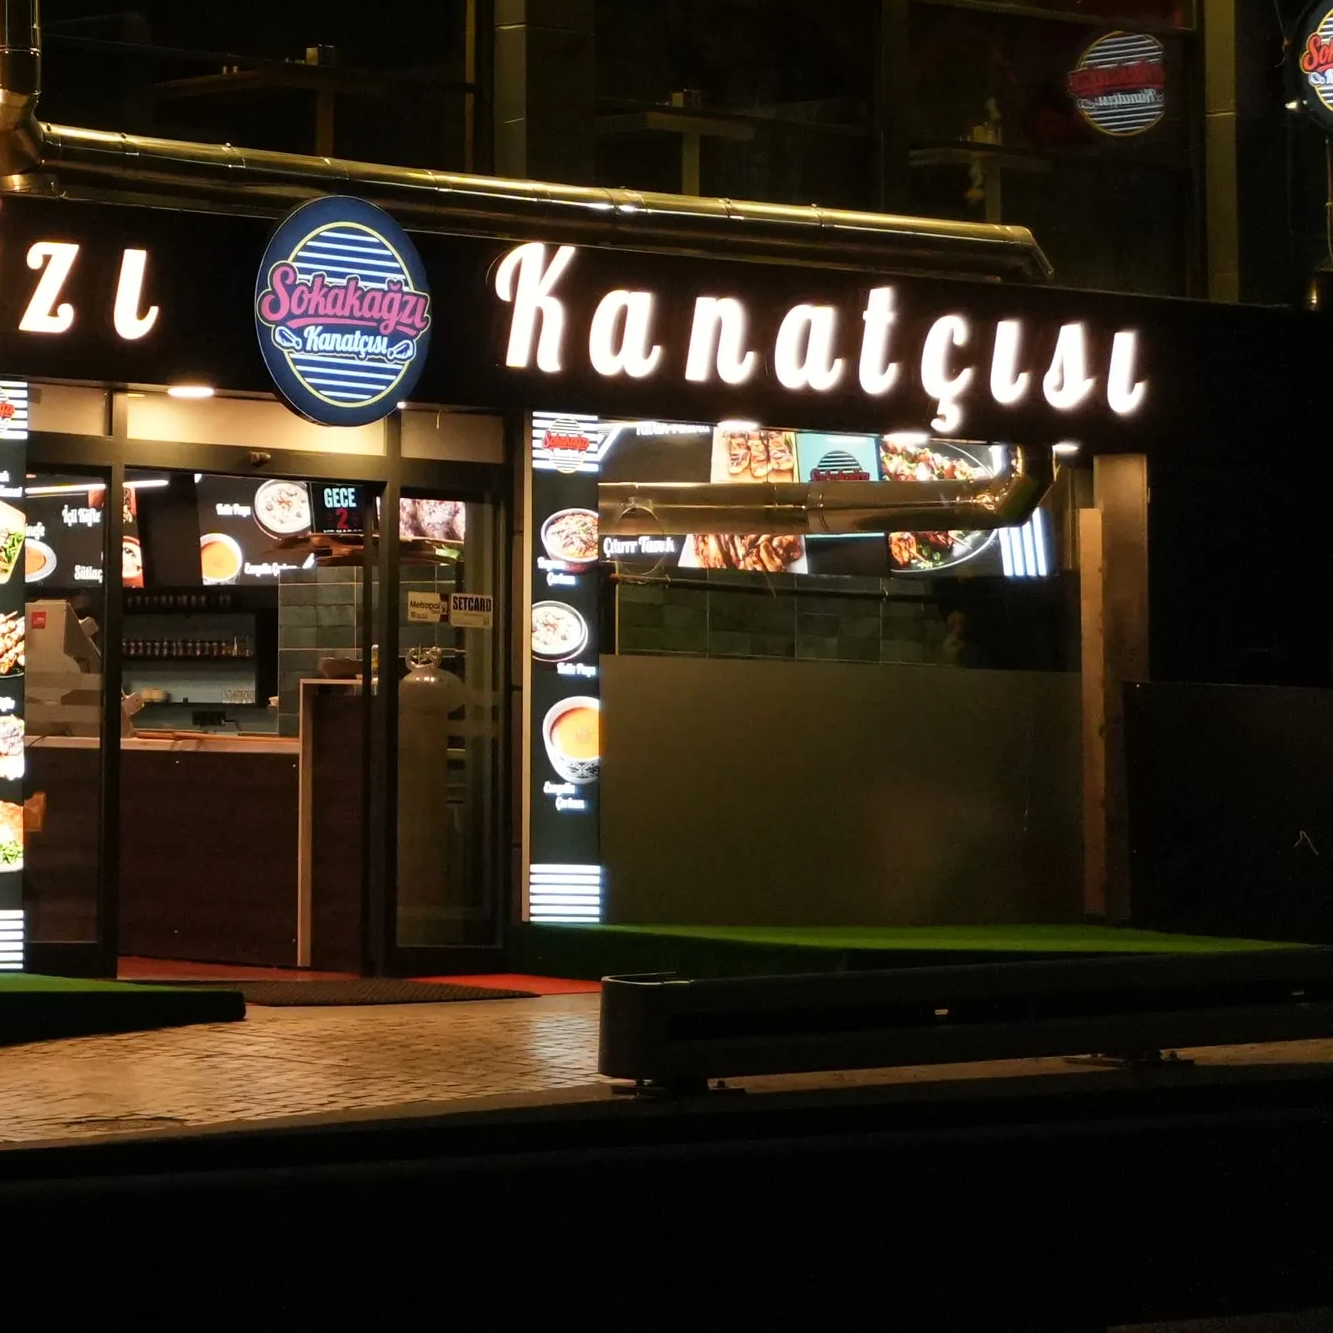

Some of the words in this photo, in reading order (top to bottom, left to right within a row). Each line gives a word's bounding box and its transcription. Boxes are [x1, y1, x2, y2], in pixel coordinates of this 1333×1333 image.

[260, 265, 429, 335] Sokakağzı
[303, 325, 390, 358] Kanatçısı
[495, 240, 1146, 434] Kanatçısı
[323, 487, 358, 508] GECE
[452, 595, 492, 613] SETCARD
